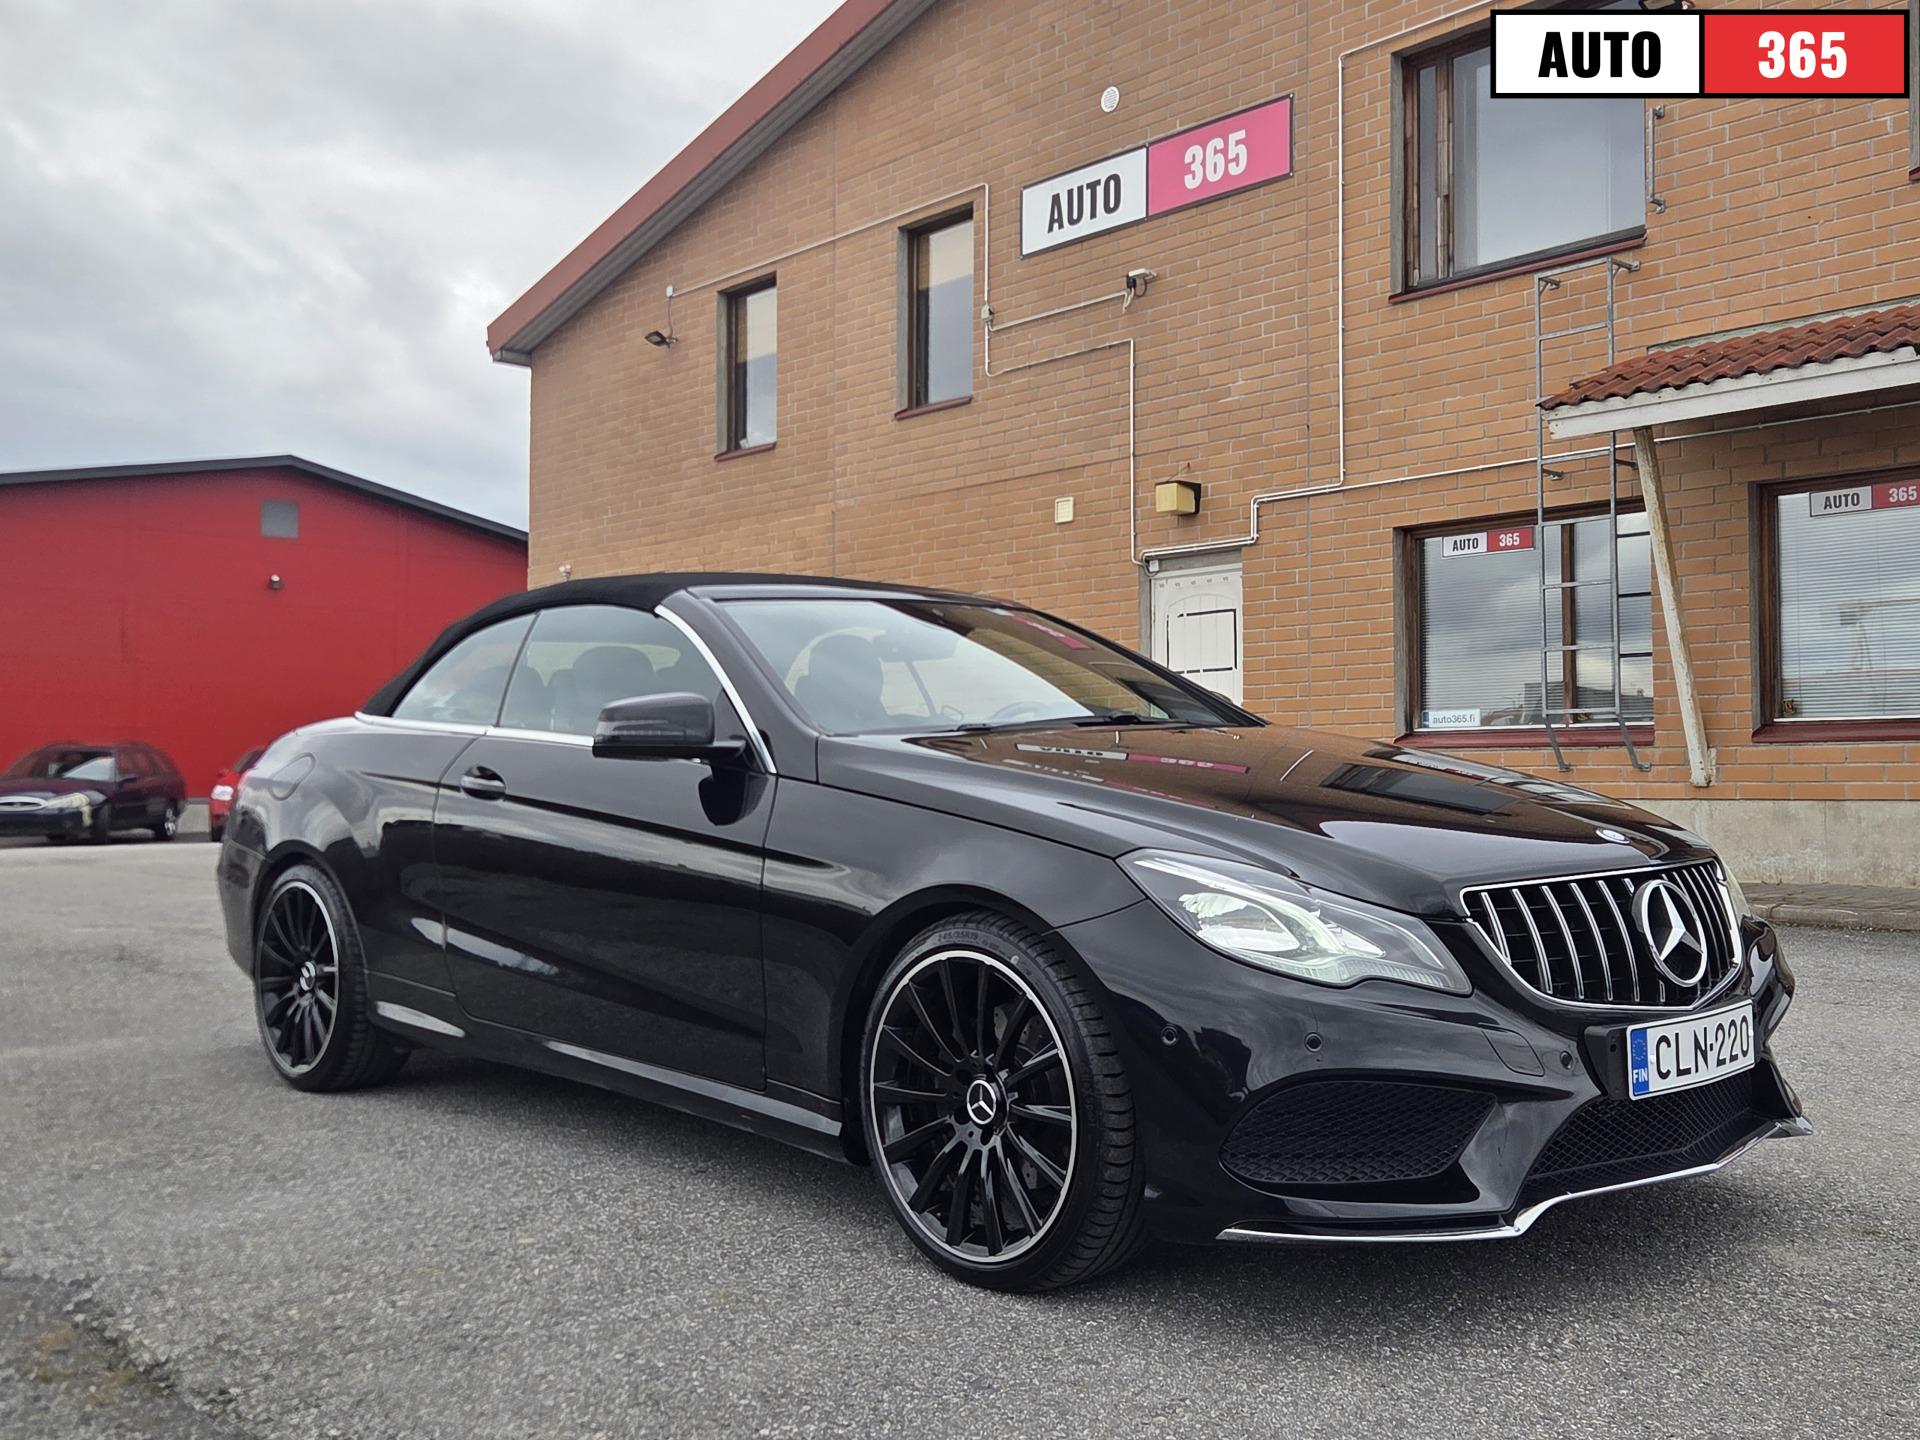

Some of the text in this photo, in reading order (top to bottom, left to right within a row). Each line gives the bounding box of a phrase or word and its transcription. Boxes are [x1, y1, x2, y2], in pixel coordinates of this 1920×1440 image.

[1047, 129, 1248, 233] AUTO 365
[1823, 486, 1917, 509] AUTO 365
[1452, 533, 1520, 552] AUTO 365
[1432, 714, 1476, 724] auto365.fi
[1655, 1015, 1750, 1080] CLN-220
[1633, 1068, 1648, 1083] FIN
